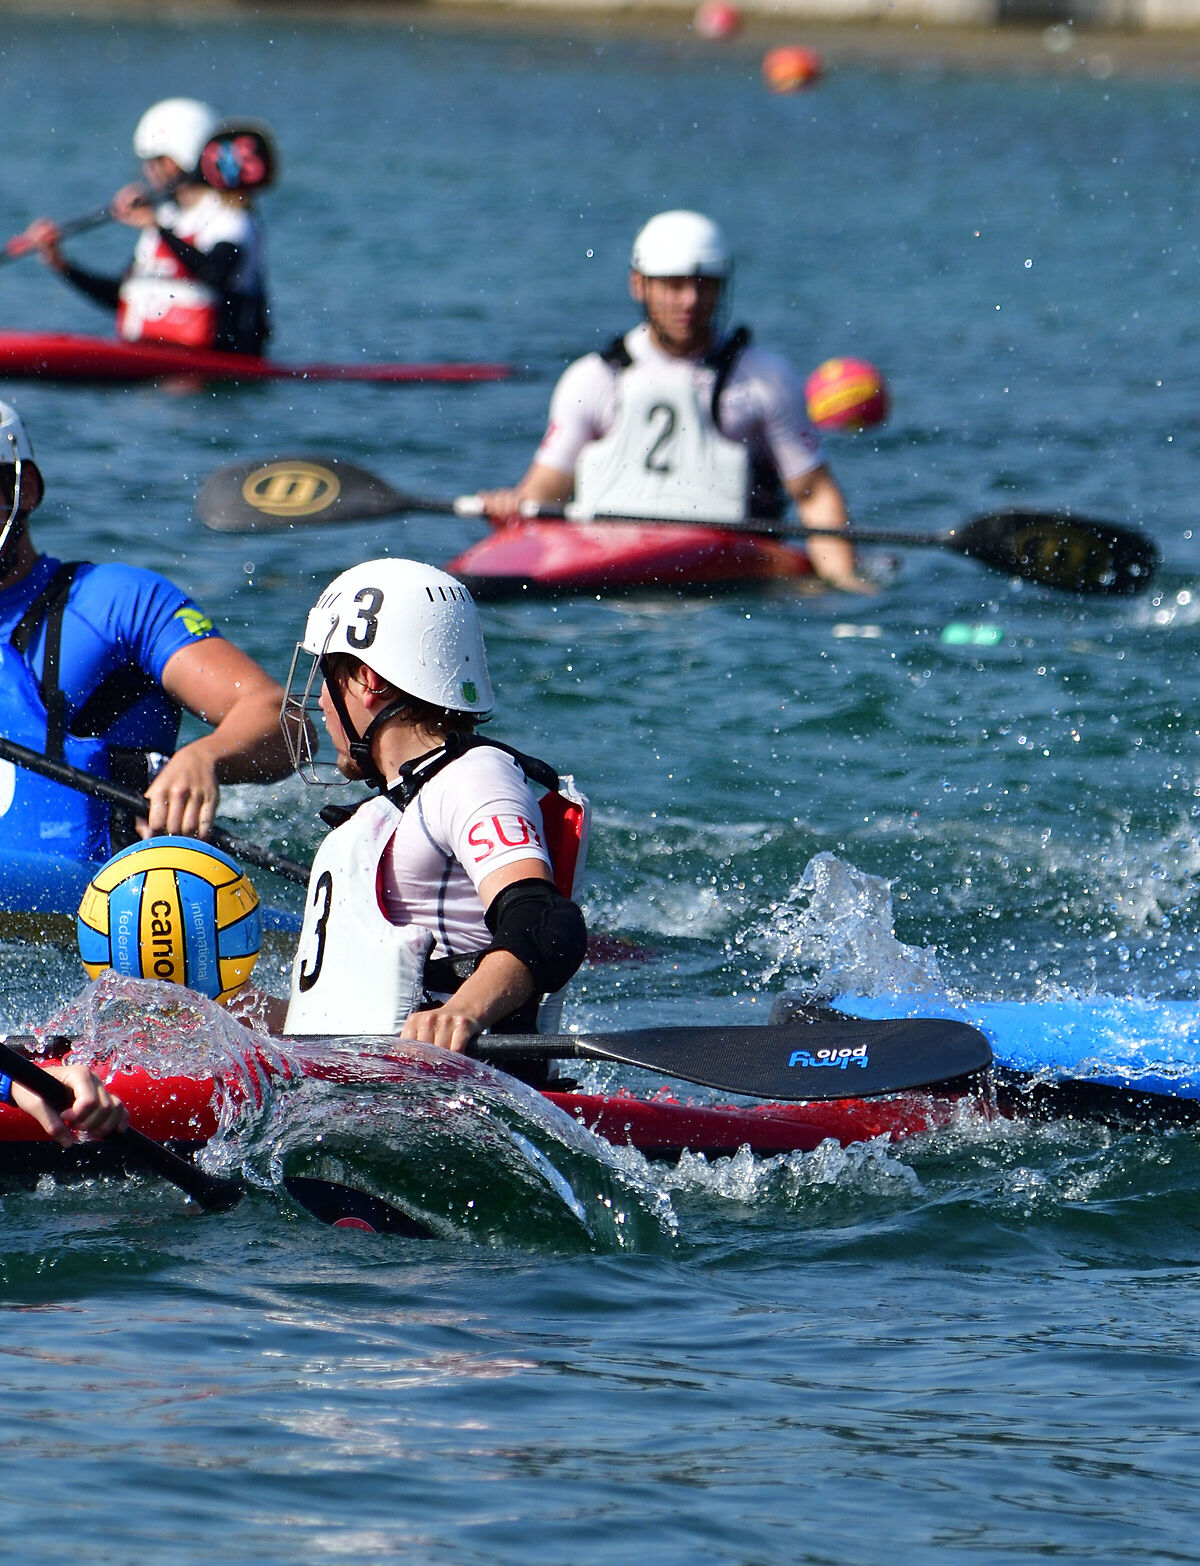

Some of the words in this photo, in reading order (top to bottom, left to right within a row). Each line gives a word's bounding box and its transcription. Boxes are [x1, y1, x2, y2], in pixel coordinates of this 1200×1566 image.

[644, 401, 676, 473] 2
[346, 587, 384, 649] 3
[150, 900, 176, 984] cano
[190, 902, 209, 981] international
[300, 870, 332, 993] 3
[817, 1044, 867, 1061] polo
